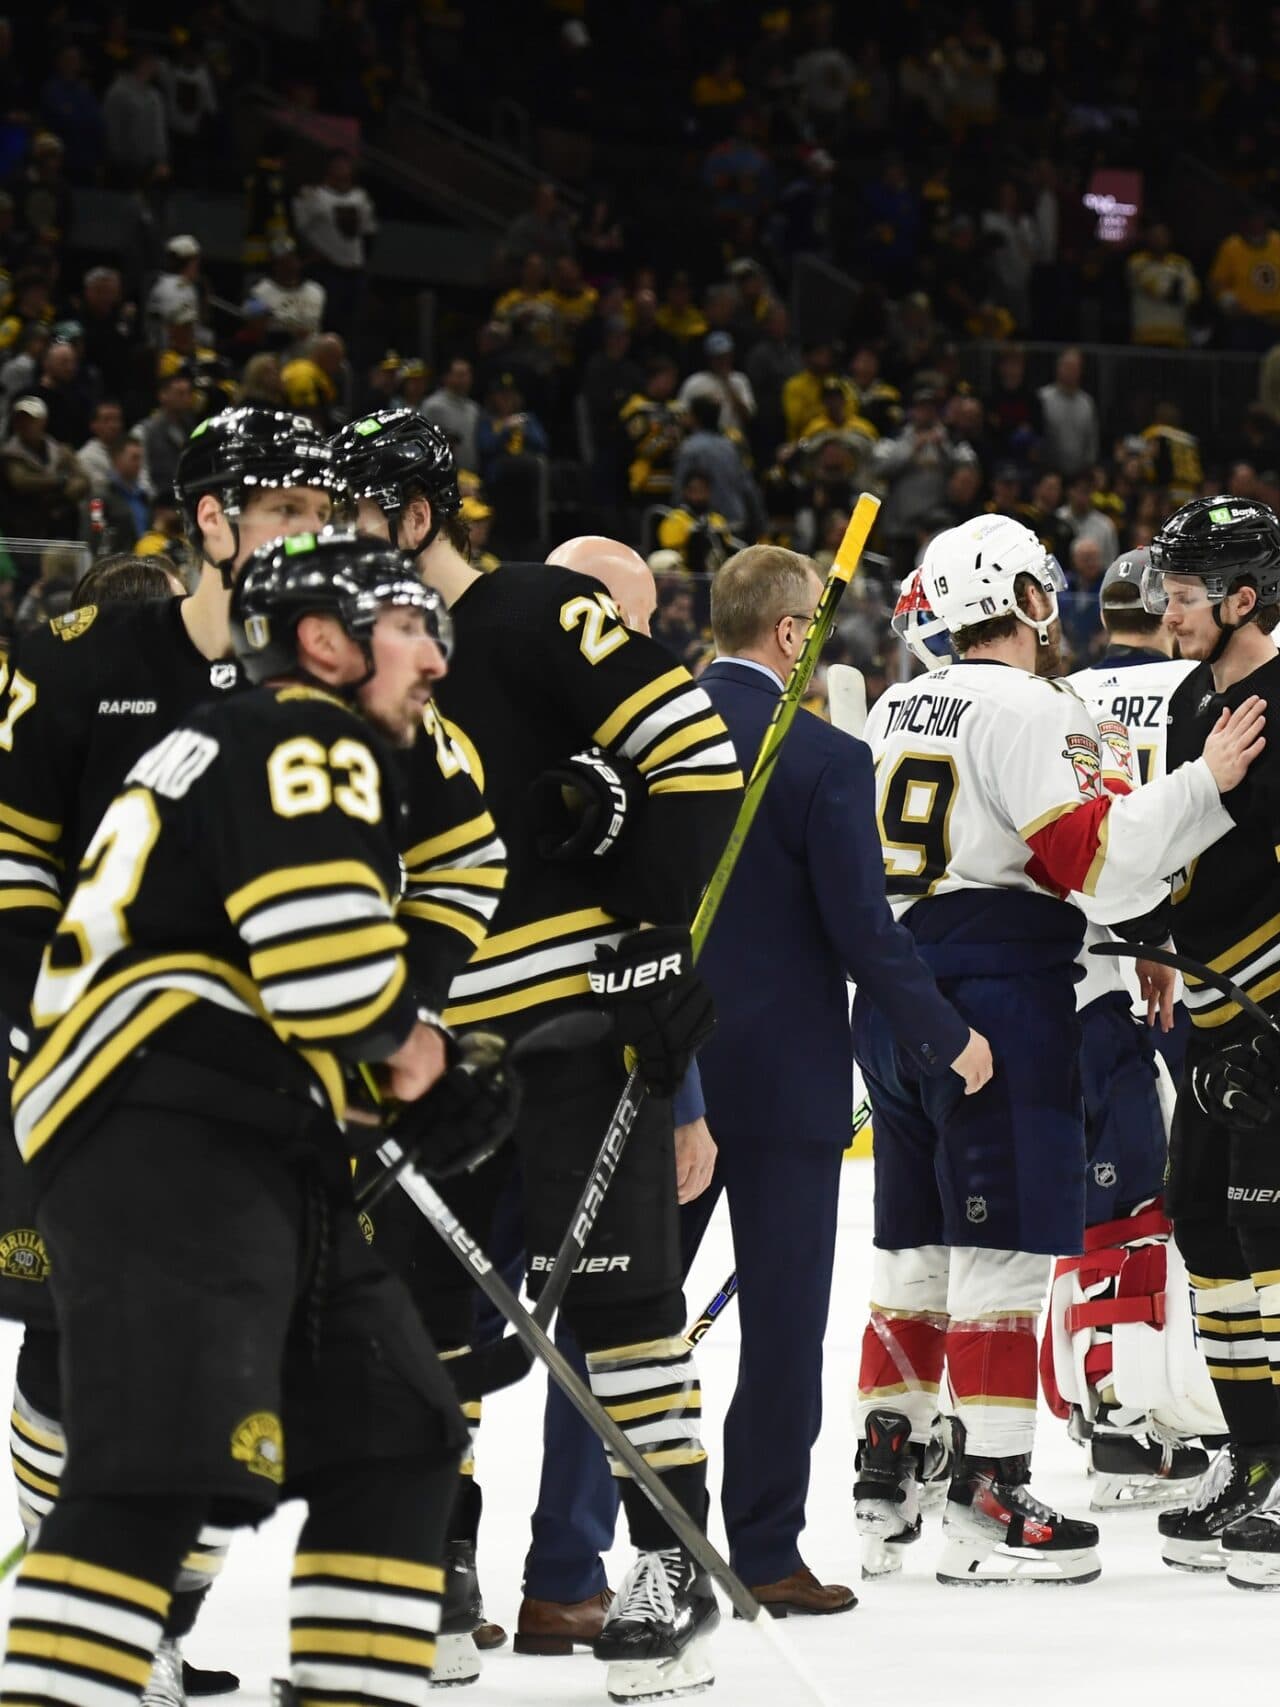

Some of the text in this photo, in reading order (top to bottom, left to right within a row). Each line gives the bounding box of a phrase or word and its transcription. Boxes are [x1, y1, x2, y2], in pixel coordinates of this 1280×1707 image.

[933, 575, 949, 598] 19
[267, 736, 382, 825] 63
[874, 751, 960, 897] 9
